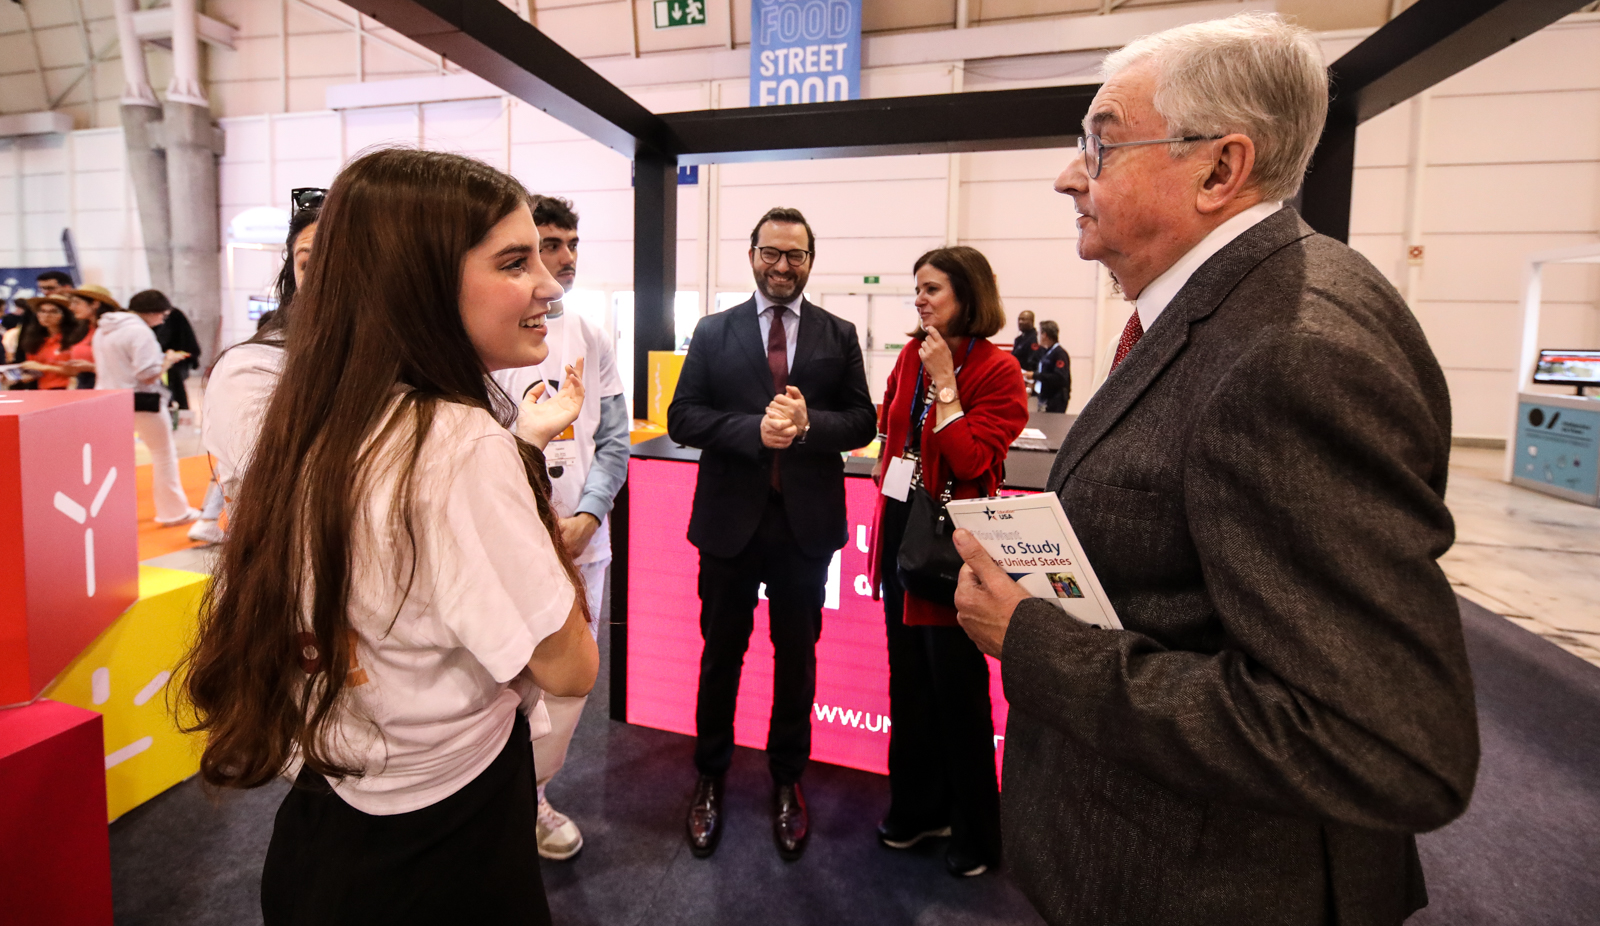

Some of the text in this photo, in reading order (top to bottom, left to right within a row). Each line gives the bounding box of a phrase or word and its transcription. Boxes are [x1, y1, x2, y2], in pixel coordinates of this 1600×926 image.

[760, 0, 852, 46] FOOD
[760, 43, 848, 77] STREET
[759, 75, 849, 107] FOOD
[992, 529, 1022, 540] Want
[1001, 540, 1060, 556] to Study
[1004, 556, 1038, 567] United
[1038, 556, 1072, 567] States
